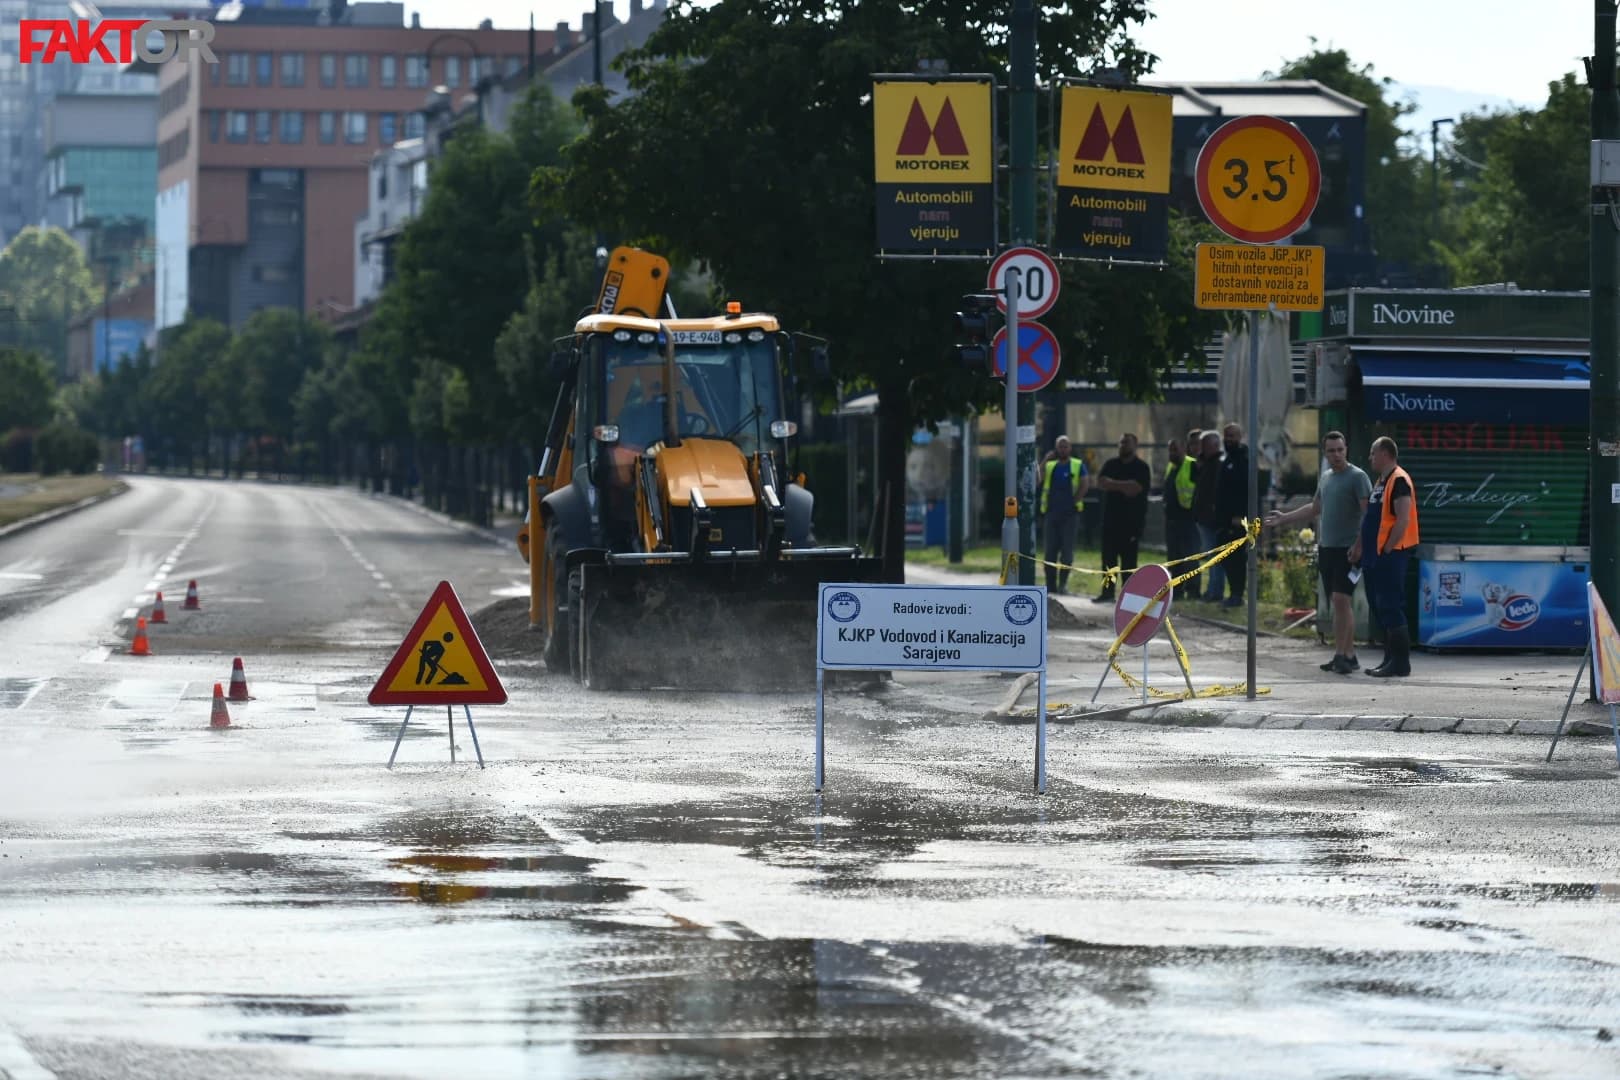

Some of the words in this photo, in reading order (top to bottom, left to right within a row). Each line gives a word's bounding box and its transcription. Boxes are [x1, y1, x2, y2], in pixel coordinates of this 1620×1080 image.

[895, 159, 970, 170] MOTOREX
[1073, 165, 1145, 179] MOTOREX
[895, 190, 973, 204] Automobili
[1070, 195, 1147, 212] Automobili
[919, 209, 950, 221] nam
[1092, 216, 1123, 228] nam
[910, 226, 960, 241] vjeruju
[1083, 231, 1132, 246] vjeruju
[1209, 247, 1234, 260] Osim
[1237, 248, 1266, 260] vozila
[1212, 262, 1243, 274] hitnih
[1244, 262, 1303, 278] intervencija
[1306, 264, 1309, 276] i
[1212, 276, 1262, 289] dostavnih
[1265, 277, 1294, 290] vozila
[1297, 280, 1309, 290] za
[1201, 289, 1267, 305] prehrambene
[1270, 292, 1319, 305] proizvode
[1373, 304, 1455, 325] iNovine
[673, 331, 721, 343] 19-E-948
[1383, 392, 1455, 412] iNovine
[1407, 423, 1565, 452] KISELJAK
[893, 602, 932, 615] Radove
[838, 627, 876, 643] KJKP
[880, 628, 937, 644] Vodovod
[940, 630, 944, 644] i
[947, 630, 1026, 648] Kanalizacija
[903, 645, 961, 662] Sarajevo
